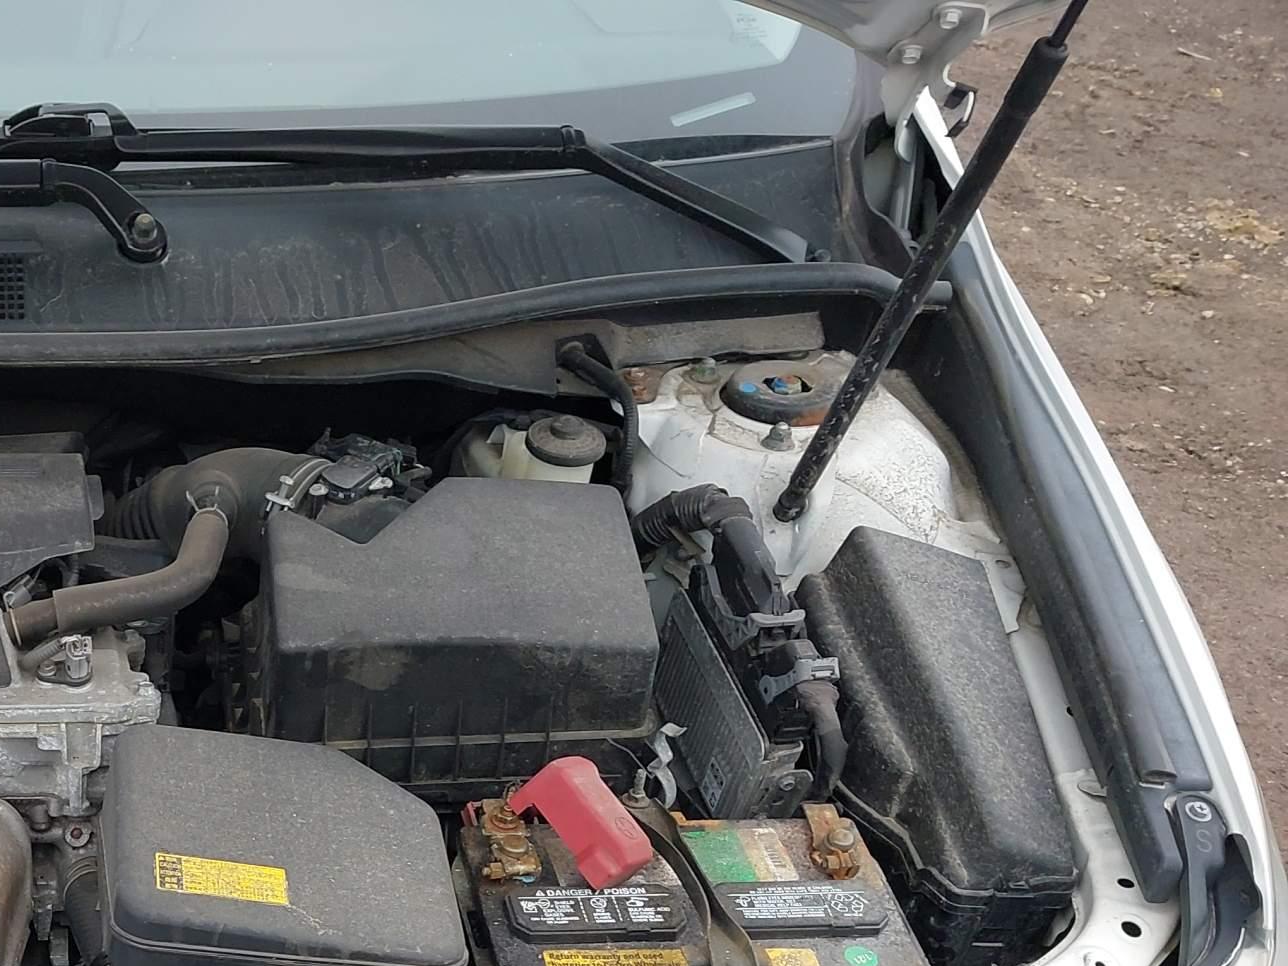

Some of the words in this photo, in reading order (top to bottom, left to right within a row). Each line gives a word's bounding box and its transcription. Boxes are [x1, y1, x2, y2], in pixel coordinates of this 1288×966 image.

[546, 888, 592, 897] DANGER
[604, 887, 647, 896] POISON
[582, 954, 622, 963] warranty
